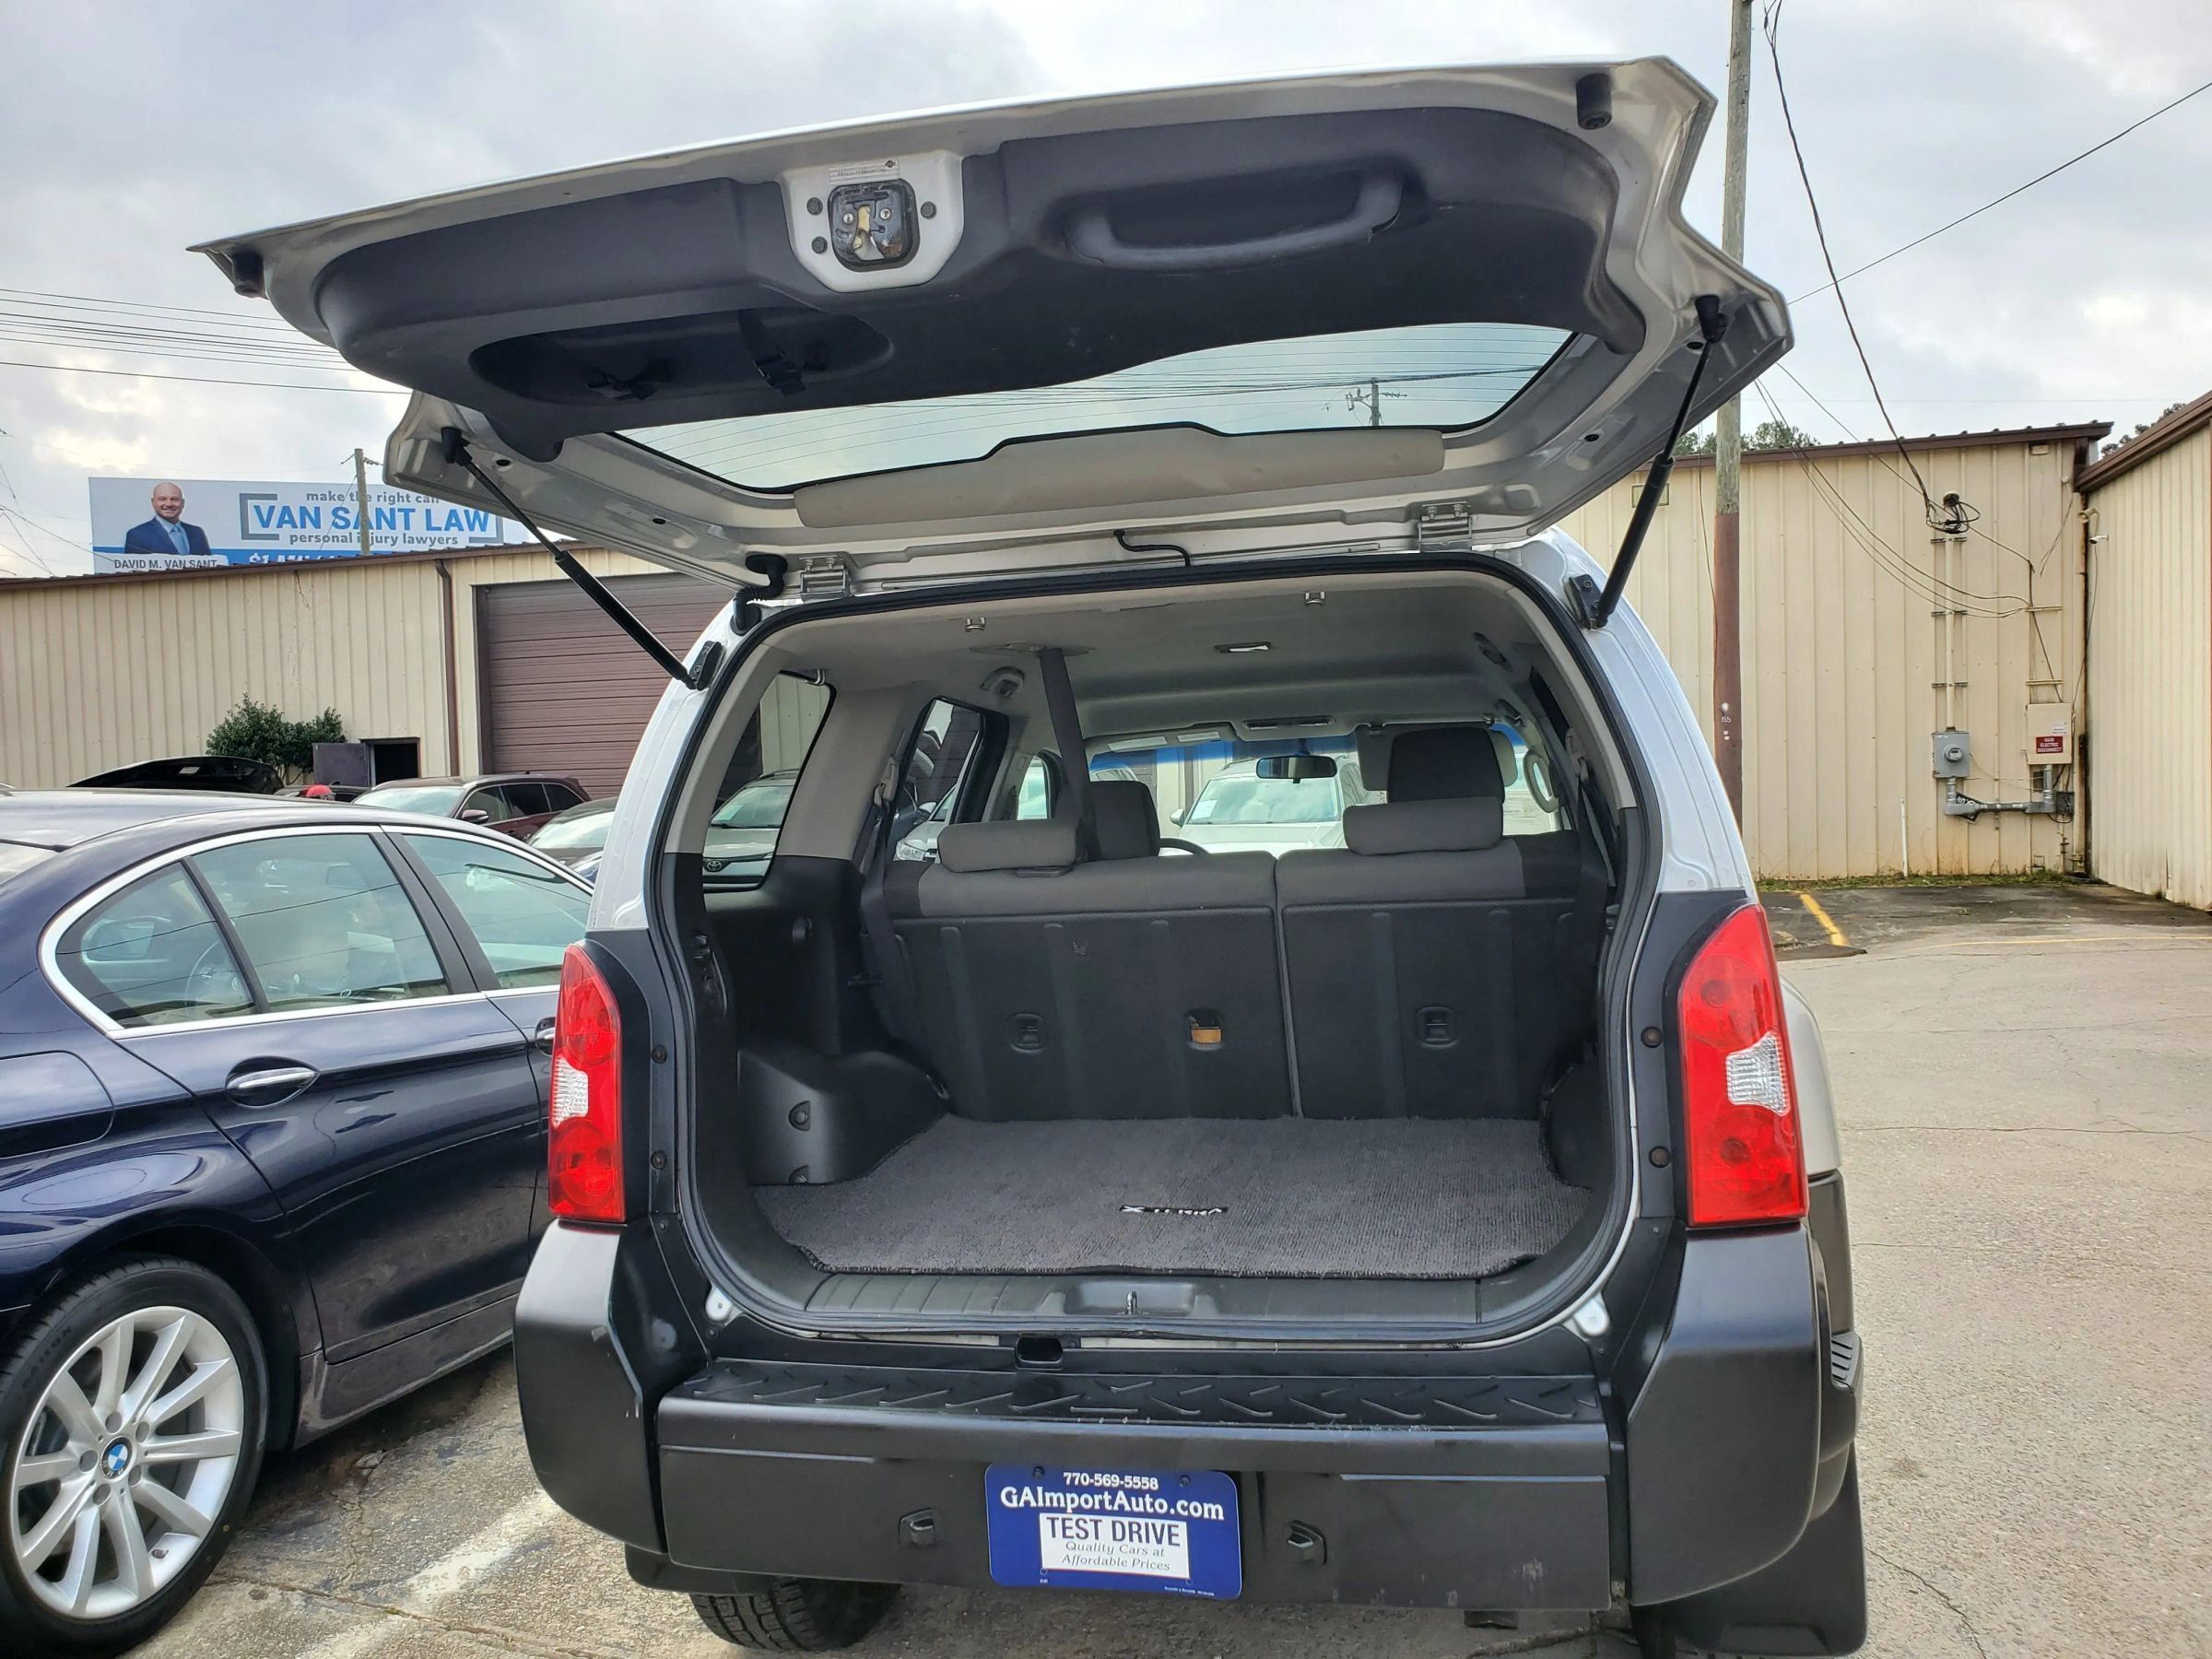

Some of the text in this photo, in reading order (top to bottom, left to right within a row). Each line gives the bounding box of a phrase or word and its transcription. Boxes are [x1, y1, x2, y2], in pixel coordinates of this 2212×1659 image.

[306, 490, 345, 502] make
[349, 491, 372, 502] te
[377, 491, 411, 505] right
[253, 505, 322, 529] VAN
[425, 508, 489, 532] LAW
[289, 532, 459, 547] personal ijury lawyers
[114, 559, 218, 569] DAVID M. VAN SANT
[1063, 1472, 1159, 1491] 770-569-5558
[1000, 1486, 1225, 1521] GAImportAuto.com
[1046, 1516, 1181, 1547] TEST DRIVE
[1065, 1540, 1165, 1558] Quality Cars at
[1062, 1554, 1171, 1571] Affordable Prices
